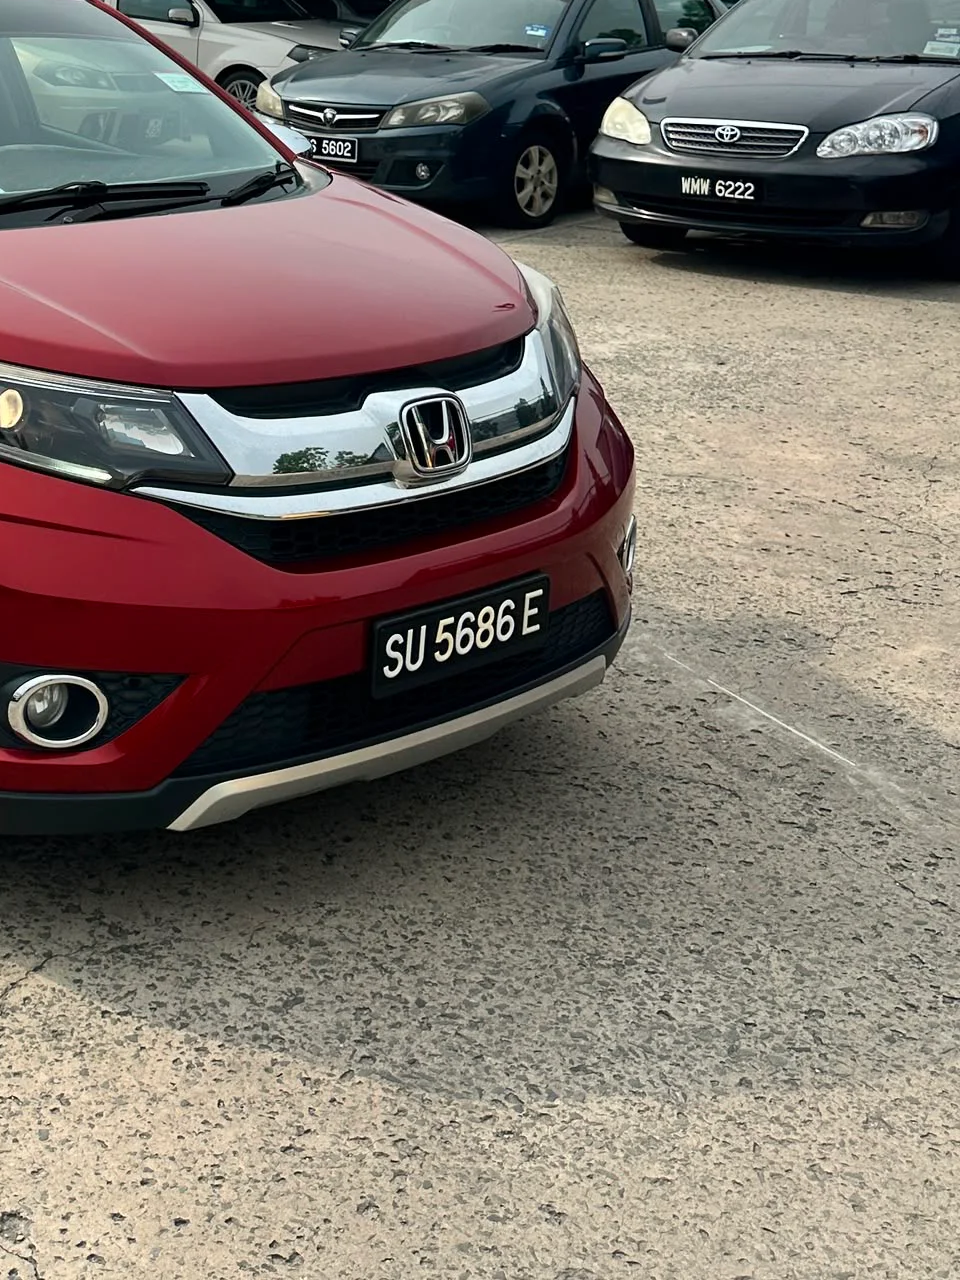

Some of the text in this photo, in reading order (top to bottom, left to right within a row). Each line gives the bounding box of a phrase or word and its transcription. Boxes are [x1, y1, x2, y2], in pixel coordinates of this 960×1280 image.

[321, 139, 352, 157] 5602
[681, 176, 755, 200] WMW 6222
[383, 588, 544, 679] SU 5686 E
